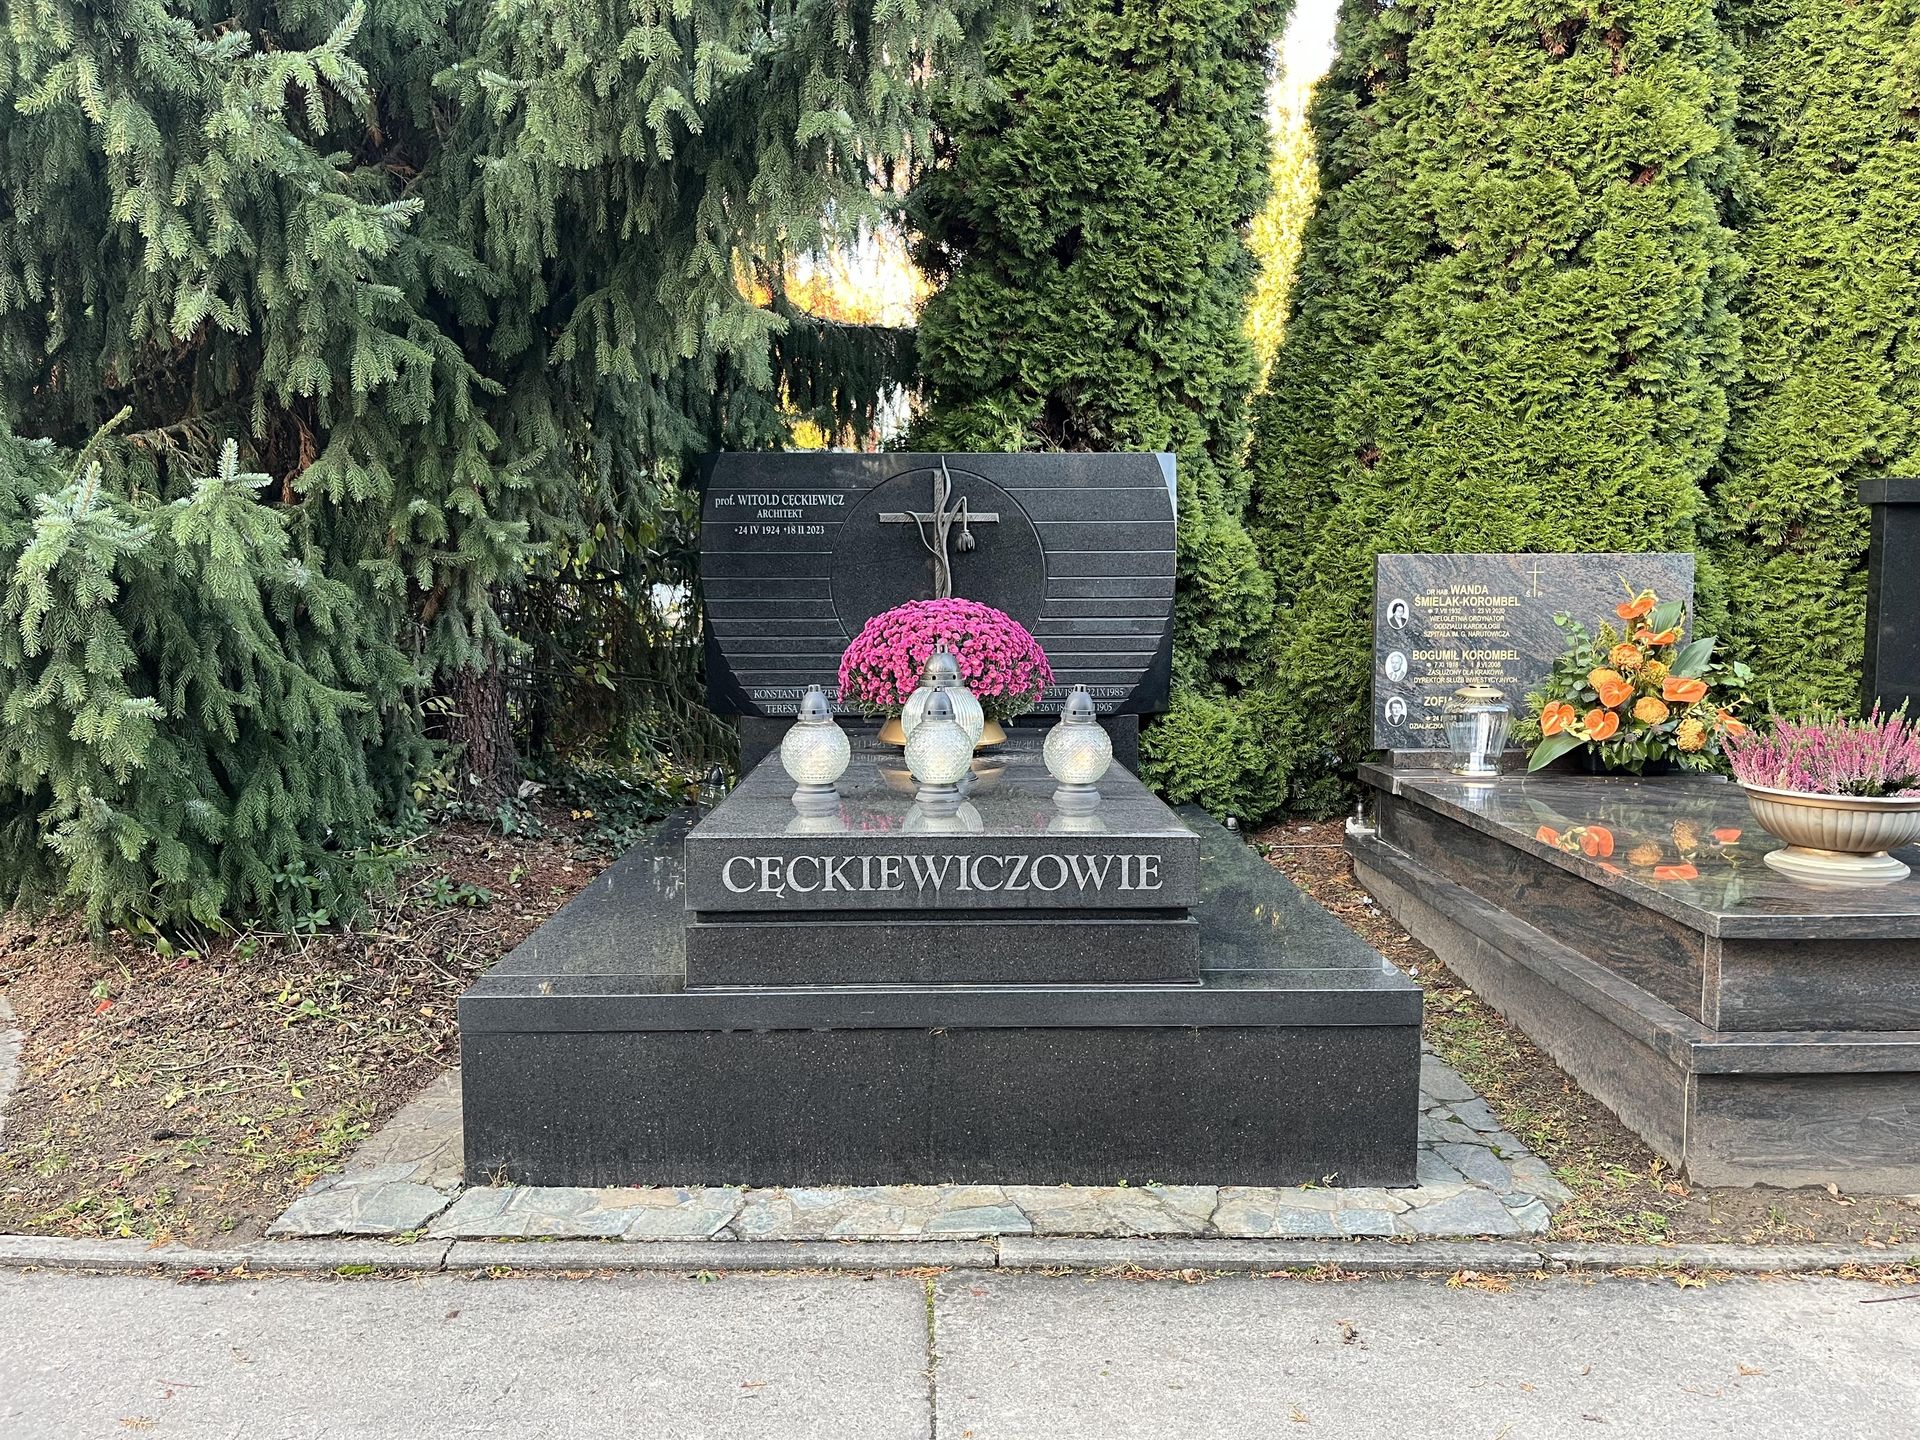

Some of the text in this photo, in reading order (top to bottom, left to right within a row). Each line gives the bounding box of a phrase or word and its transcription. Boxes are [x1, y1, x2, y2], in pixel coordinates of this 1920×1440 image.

[715, 494, 845, 508] prof. WITOLD CĘCKIEWICZ
[757, 509, 803, 518] ARCHITEKT
[750, 526, 759, 534] IV
[762, 526, 780, 535] 1924
[798, 526, 805, 534] II
[806, 526, 825, 535] 2023
[1450, 585, 1489, 595] WANDA
[1414, 594, 1521, 607] ŚMIELAK-KOROMBEL
[1412, 650, 1520, 660] BOGUMIŁ KOROMBEL
[754, 689, 805, 699] KONSTANTY
[1107, 688, 1124, 697] 1985
[766, 704, 798, 714] TERESA
[1040, 703, 1049, 711] 26
[1097, 703, 1113, 711] 1905
[721, 854, 1164, 899] CĘCKIEWICZOWIE
